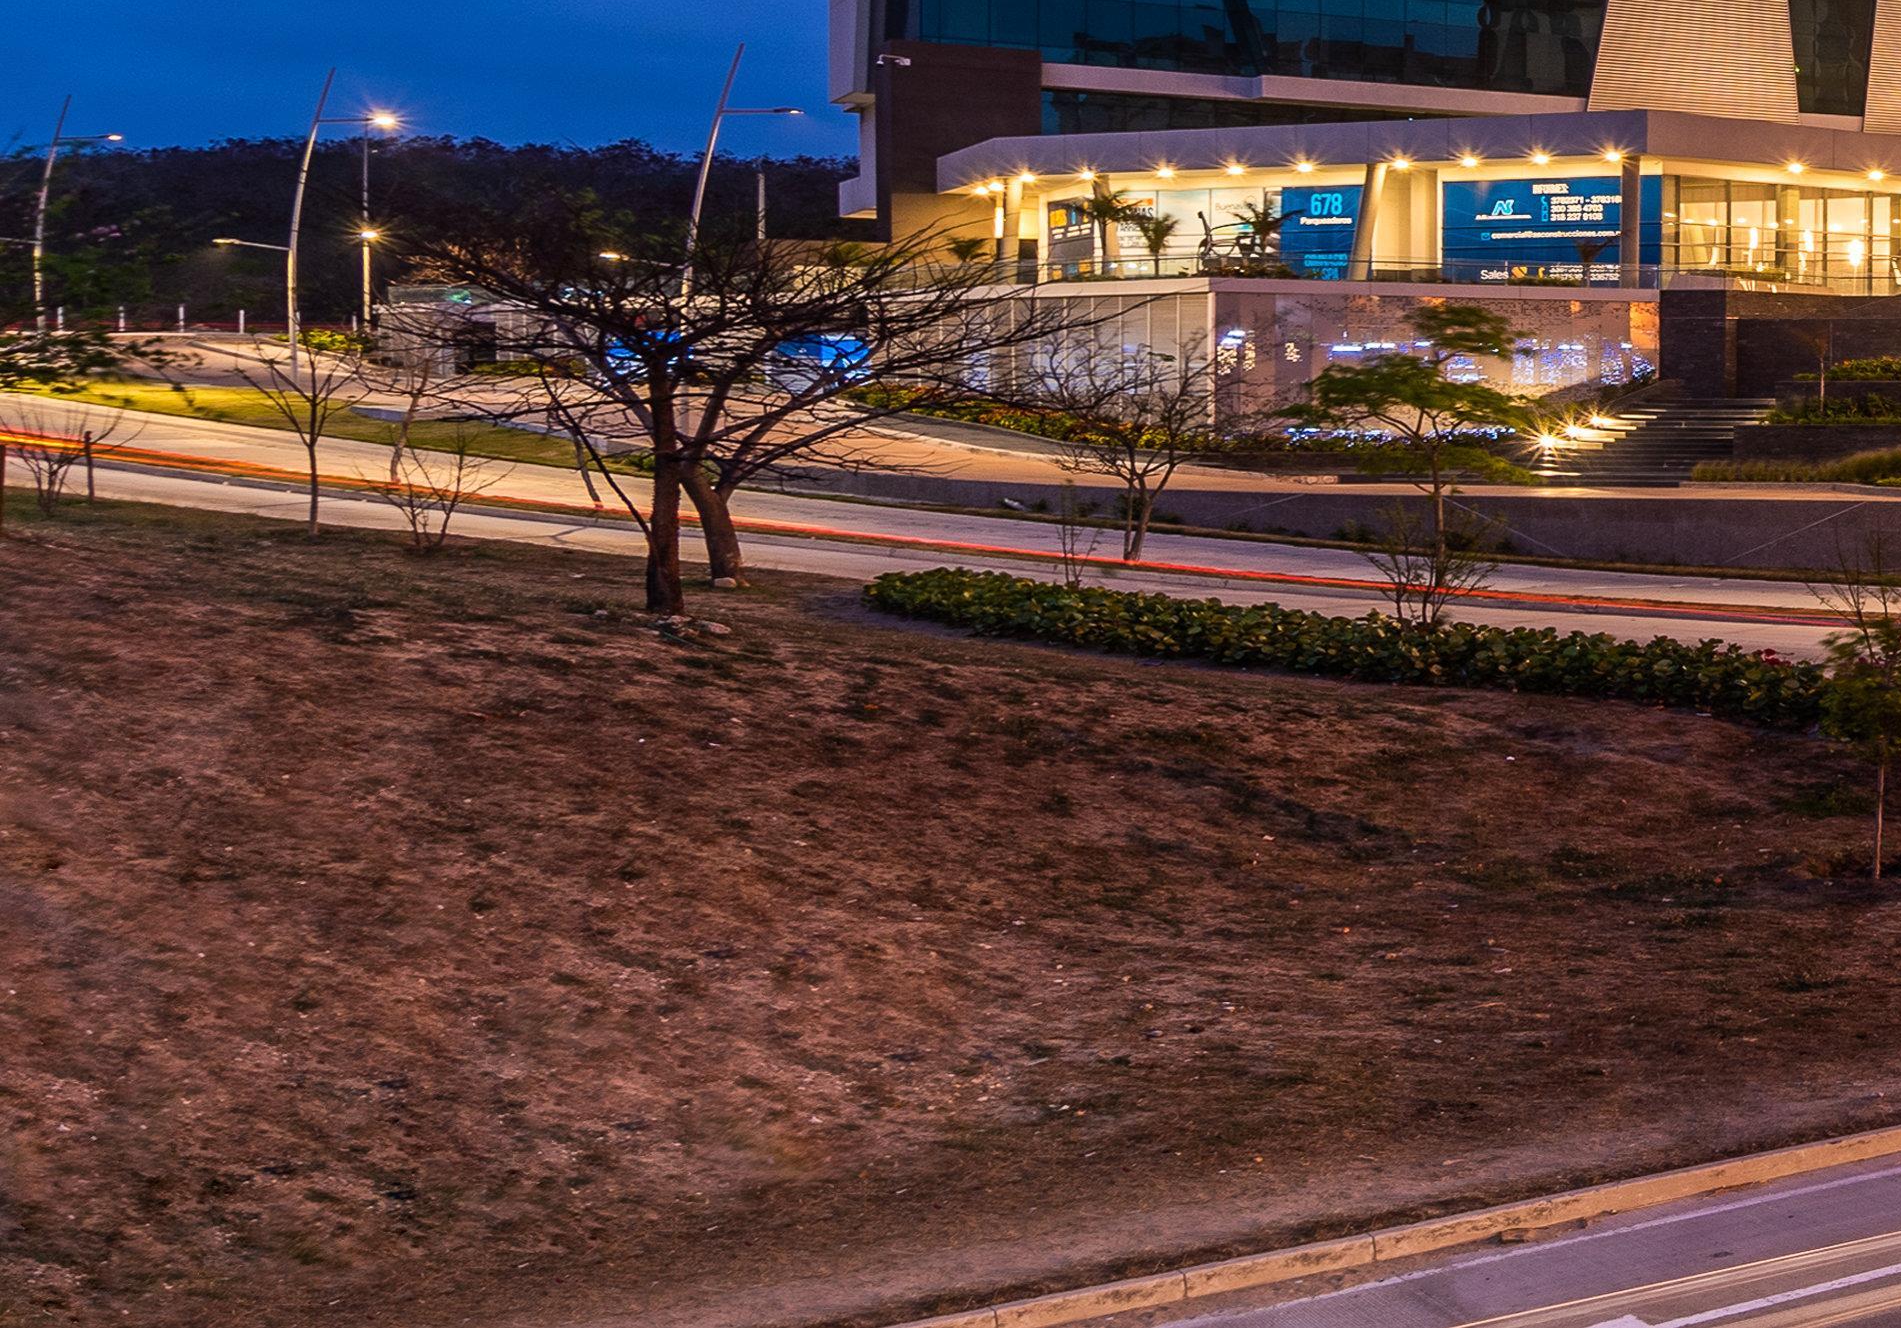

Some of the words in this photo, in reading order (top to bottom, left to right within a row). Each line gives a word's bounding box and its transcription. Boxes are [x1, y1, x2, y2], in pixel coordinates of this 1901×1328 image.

[1310, 193, 1343, 216] 678
[1299, 216, 1353, 226] Parqueaderos
[1480, 269, 1509, 280] Sales
